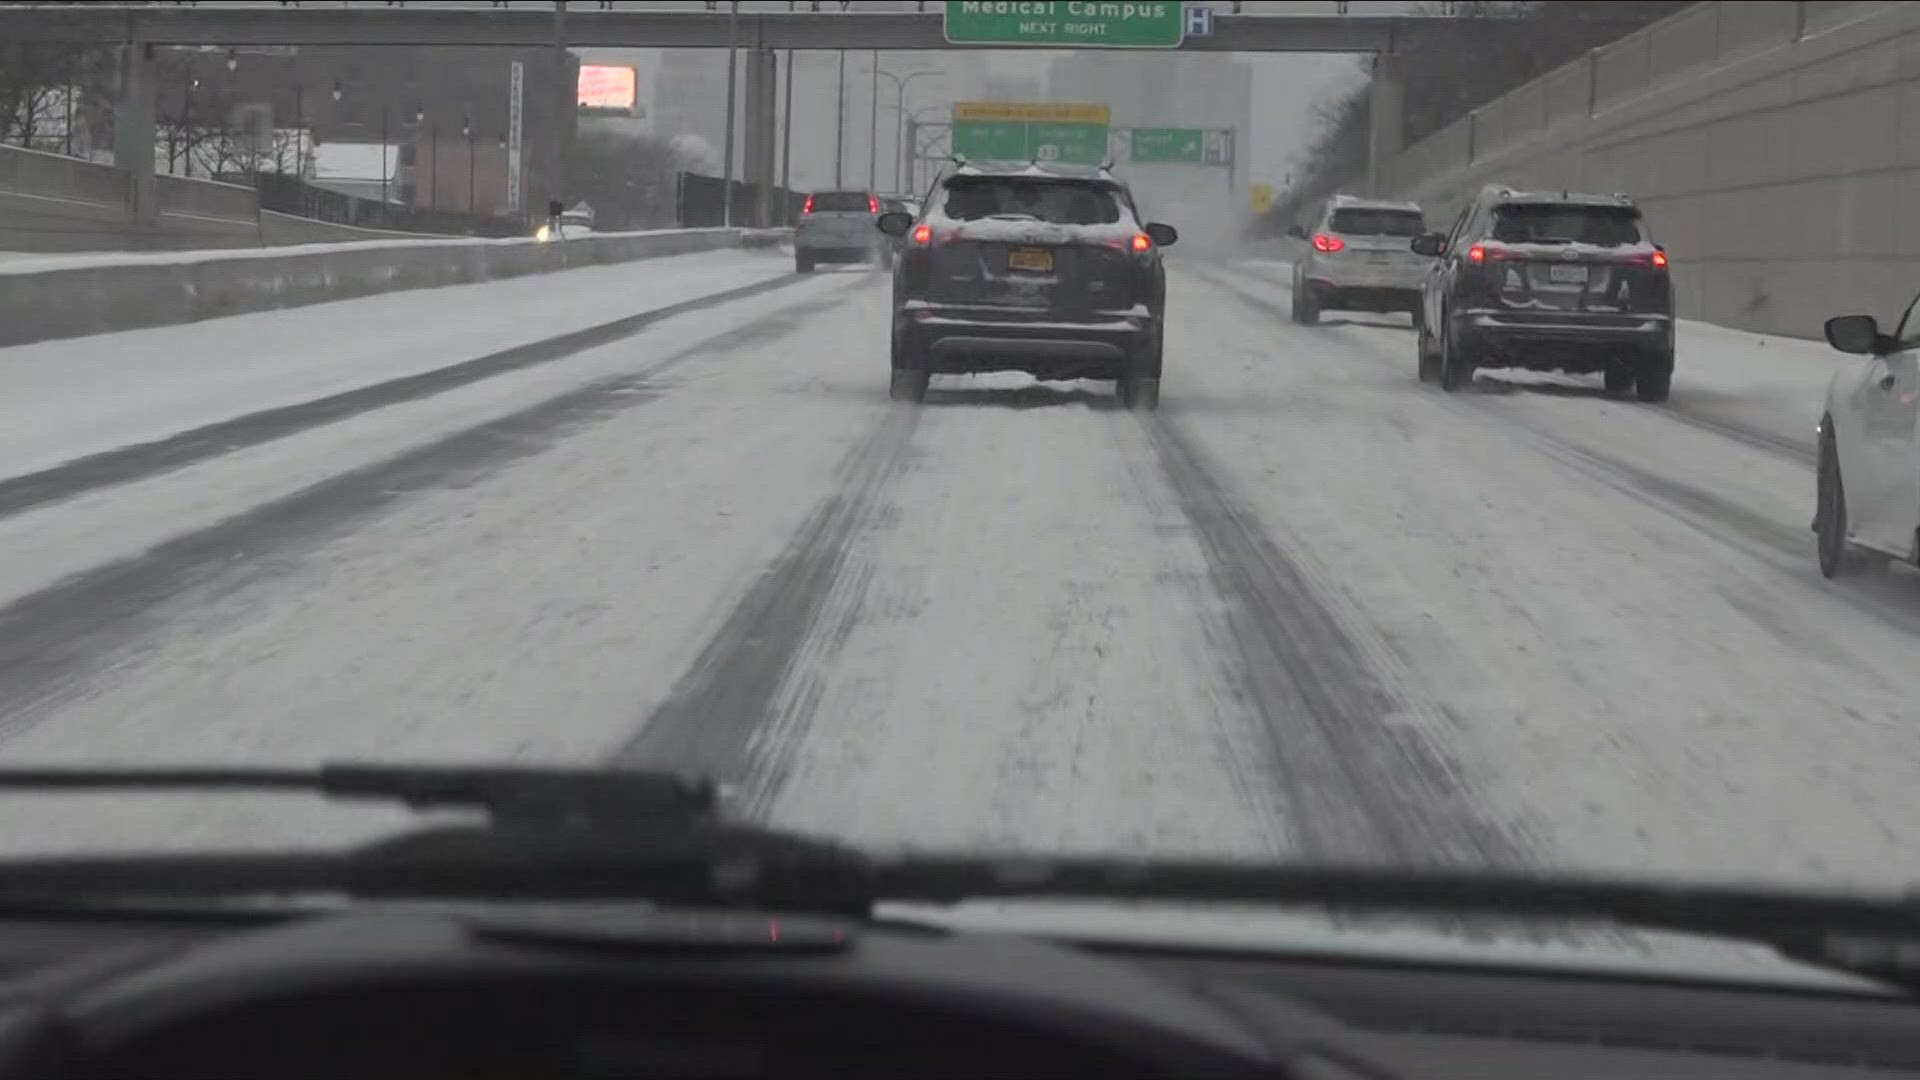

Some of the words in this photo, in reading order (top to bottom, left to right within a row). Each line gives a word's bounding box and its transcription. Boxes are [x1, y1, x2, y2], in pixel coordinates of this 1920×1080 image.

[963, 1, 1055, 15] Medical
[1068, 1, 1165, 20] Campus
[1019, 23, 1056, 34] NEXT
[1064, 23, 1106, 35] RIGHT
[1187, 8, 1209, 34] H
